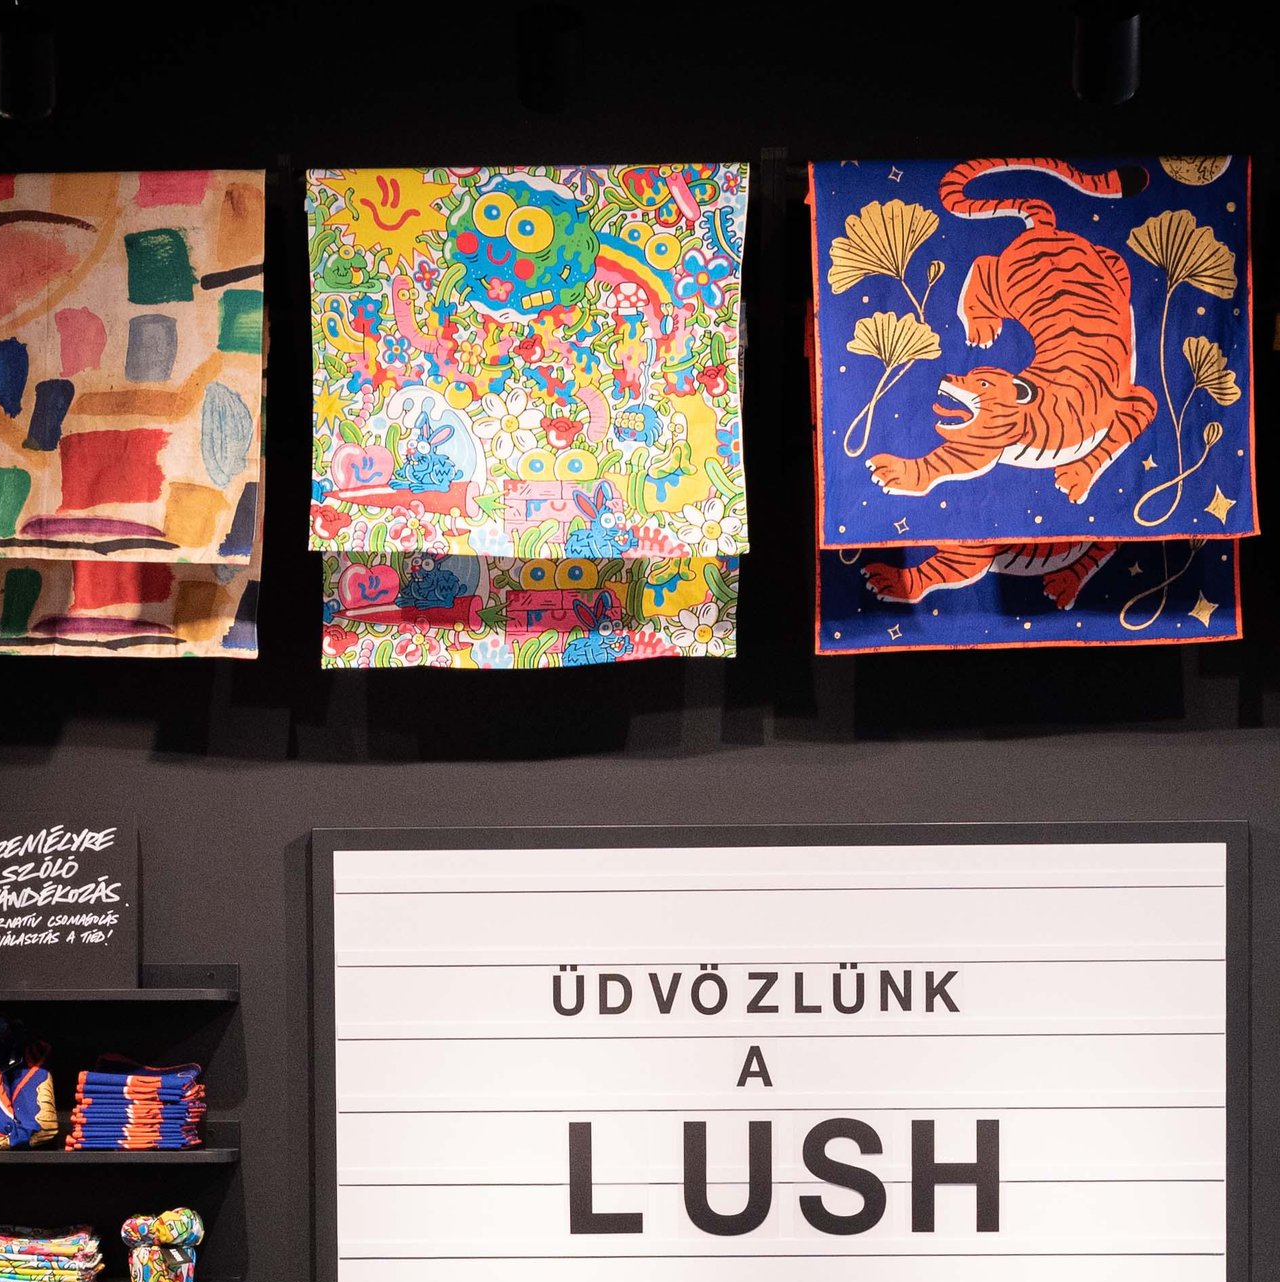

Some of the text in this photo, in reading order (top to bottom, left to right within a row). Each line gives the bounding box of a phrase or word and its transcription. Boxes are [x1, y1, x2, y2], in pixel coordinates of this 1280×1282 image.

[47, 910, 120, 927] CSOMAGOLÁS
[66, 931, 76, 944] A
[81, 928, 114, 946] TIÉD!
[551, 963, 961, 1016] ÜDVÖZLÜNK
[736, 1045, 774, 1088] A
[568, 1117, 1001, 1236] LUSH
